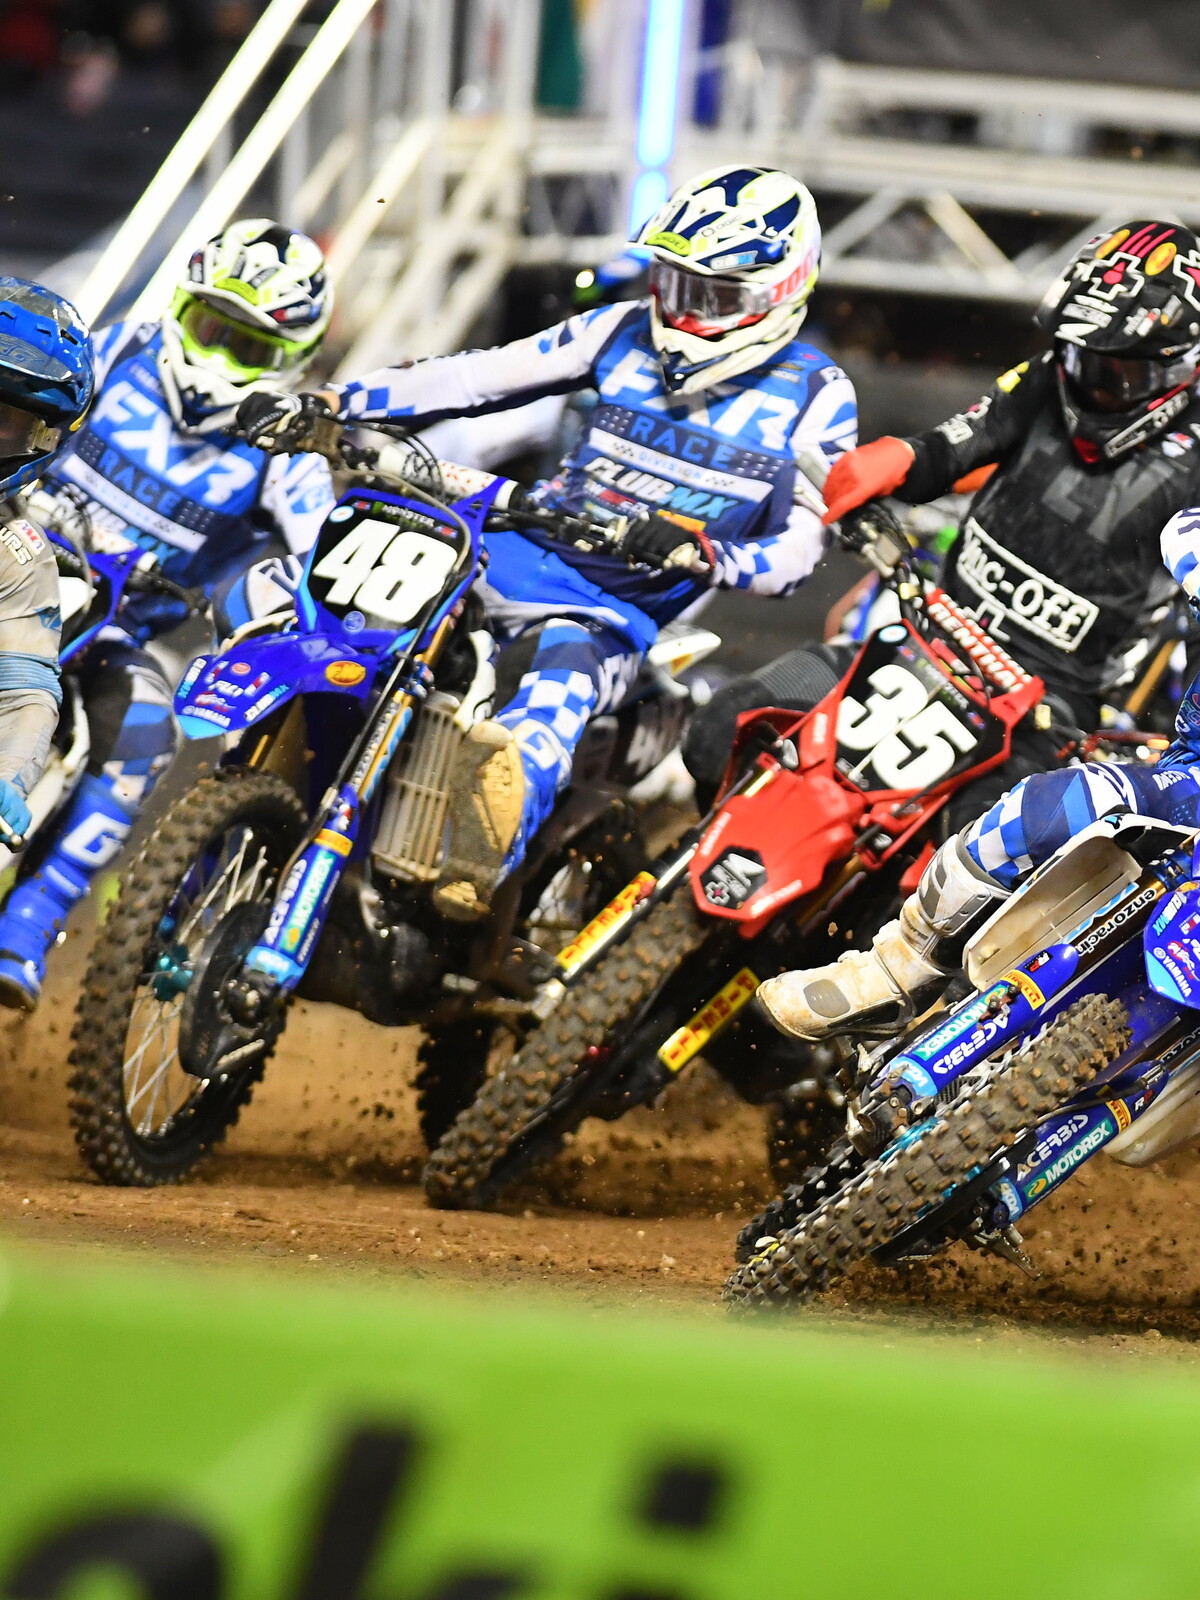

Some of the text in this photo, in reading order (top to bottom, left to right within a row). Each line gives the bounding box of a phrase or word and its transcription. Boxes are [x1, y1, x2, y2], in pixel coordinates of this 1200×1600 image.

[629, 416, 740, 471] RACE
[583, 457, 738, 521] CLUBMX
[312, 517, 459, 623] 48
[927, 602, 1025, 694] RENTHAL
[194, 706, 232, 728] YAMAHA
[243, 682, 291, 723] CLUBMX
[835, 664, 978, 791] 35
[1113, 887, 1157, 929] enzo
[1077, 918, 1118, 956] racin
[1162, 954, 1193, 998] YAMAHA
[918, 1001, 987, 1058] MOTOREX
[1045, 1122, 1110, 1184] MOTOREX
